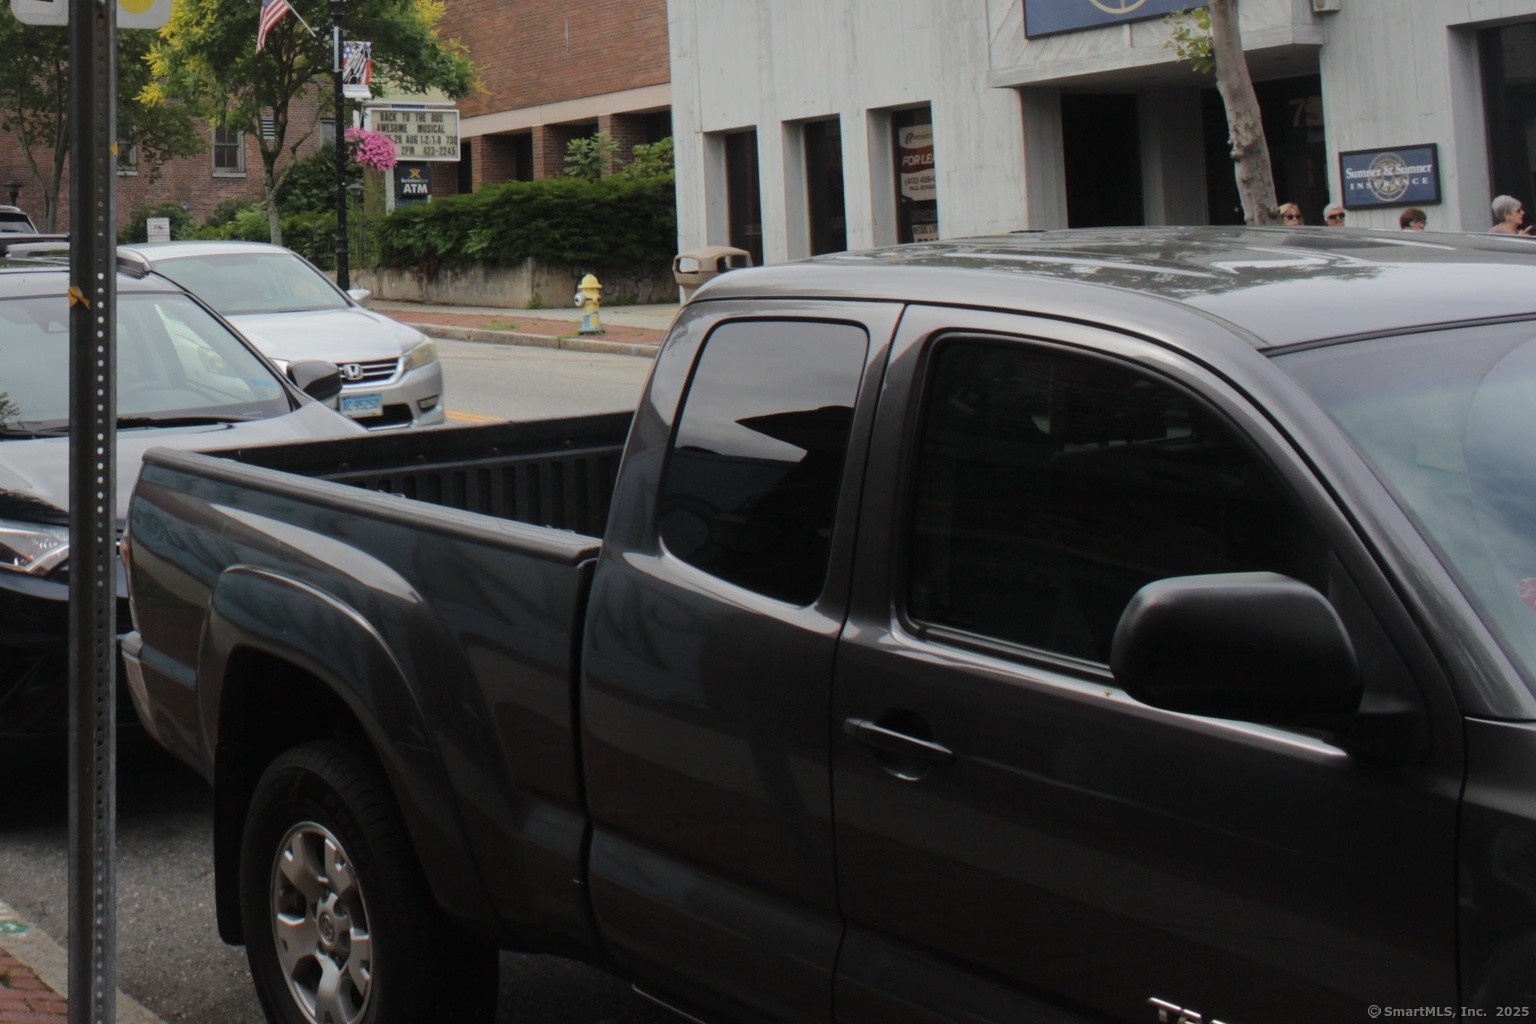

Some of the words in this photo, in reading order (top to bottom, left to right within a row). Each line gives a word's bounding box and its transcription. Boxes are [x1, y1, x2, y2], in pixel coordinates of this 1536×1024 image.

[380, 112, 396, 122] BACK
[402, 113, 410, 122] TO
[415, 113, 426, 122] THE
[377, 124, 407, 133] AWESOME
[417, 124, 445, 133] MUSICAL
[406, 136, 418, 144] AUG
[401, 146, 415, 155] 2PM
[902, 155, 920, 166] FOR
[1346, 166, 1382, 179] Sumner
[1383, 166, 1394, 176] &
[1395, 163, 1432, 175] Sumner
[403, 184, 428, 194] ATM
[1350, 177, 1430, 191] INSURANCE
